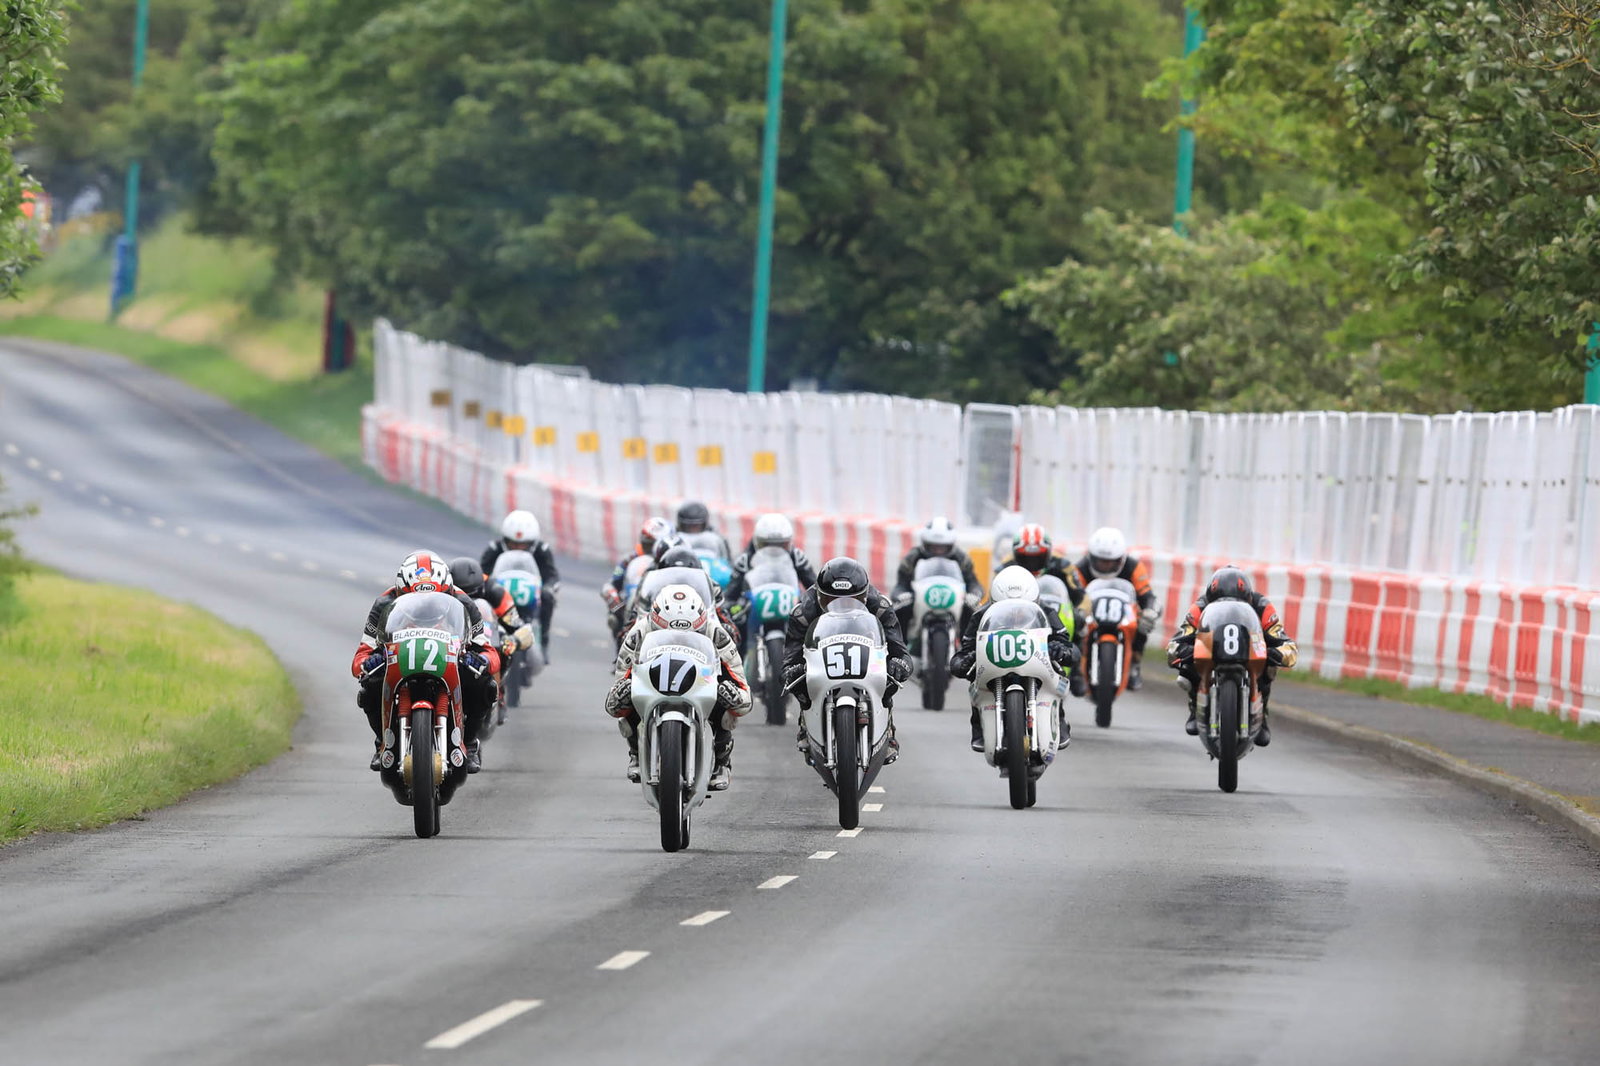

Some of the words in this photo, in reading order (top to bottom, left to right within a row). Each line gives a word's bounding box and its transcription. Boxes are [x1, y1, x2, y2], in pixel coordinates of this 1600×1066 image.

[759, 590, 791, 618] 28
[928, 588, 952, 606] 87
[1095, 598, 1123, 622] 48
[393, 629, 451, 641] BLACKFORDS
[671, 620, 690, 628] Arai
[819, 635, 874, 647] BLACKFORDS
[992, 633, 1032, 663] 103
[1223, 624, 1239, 655] 8
[406, 638, 439, 671] 12
[648, 646, 706, 661] BLACKFORDS
[826, 644, 862, 677] 51
[650, 652, 695, 692] 17
